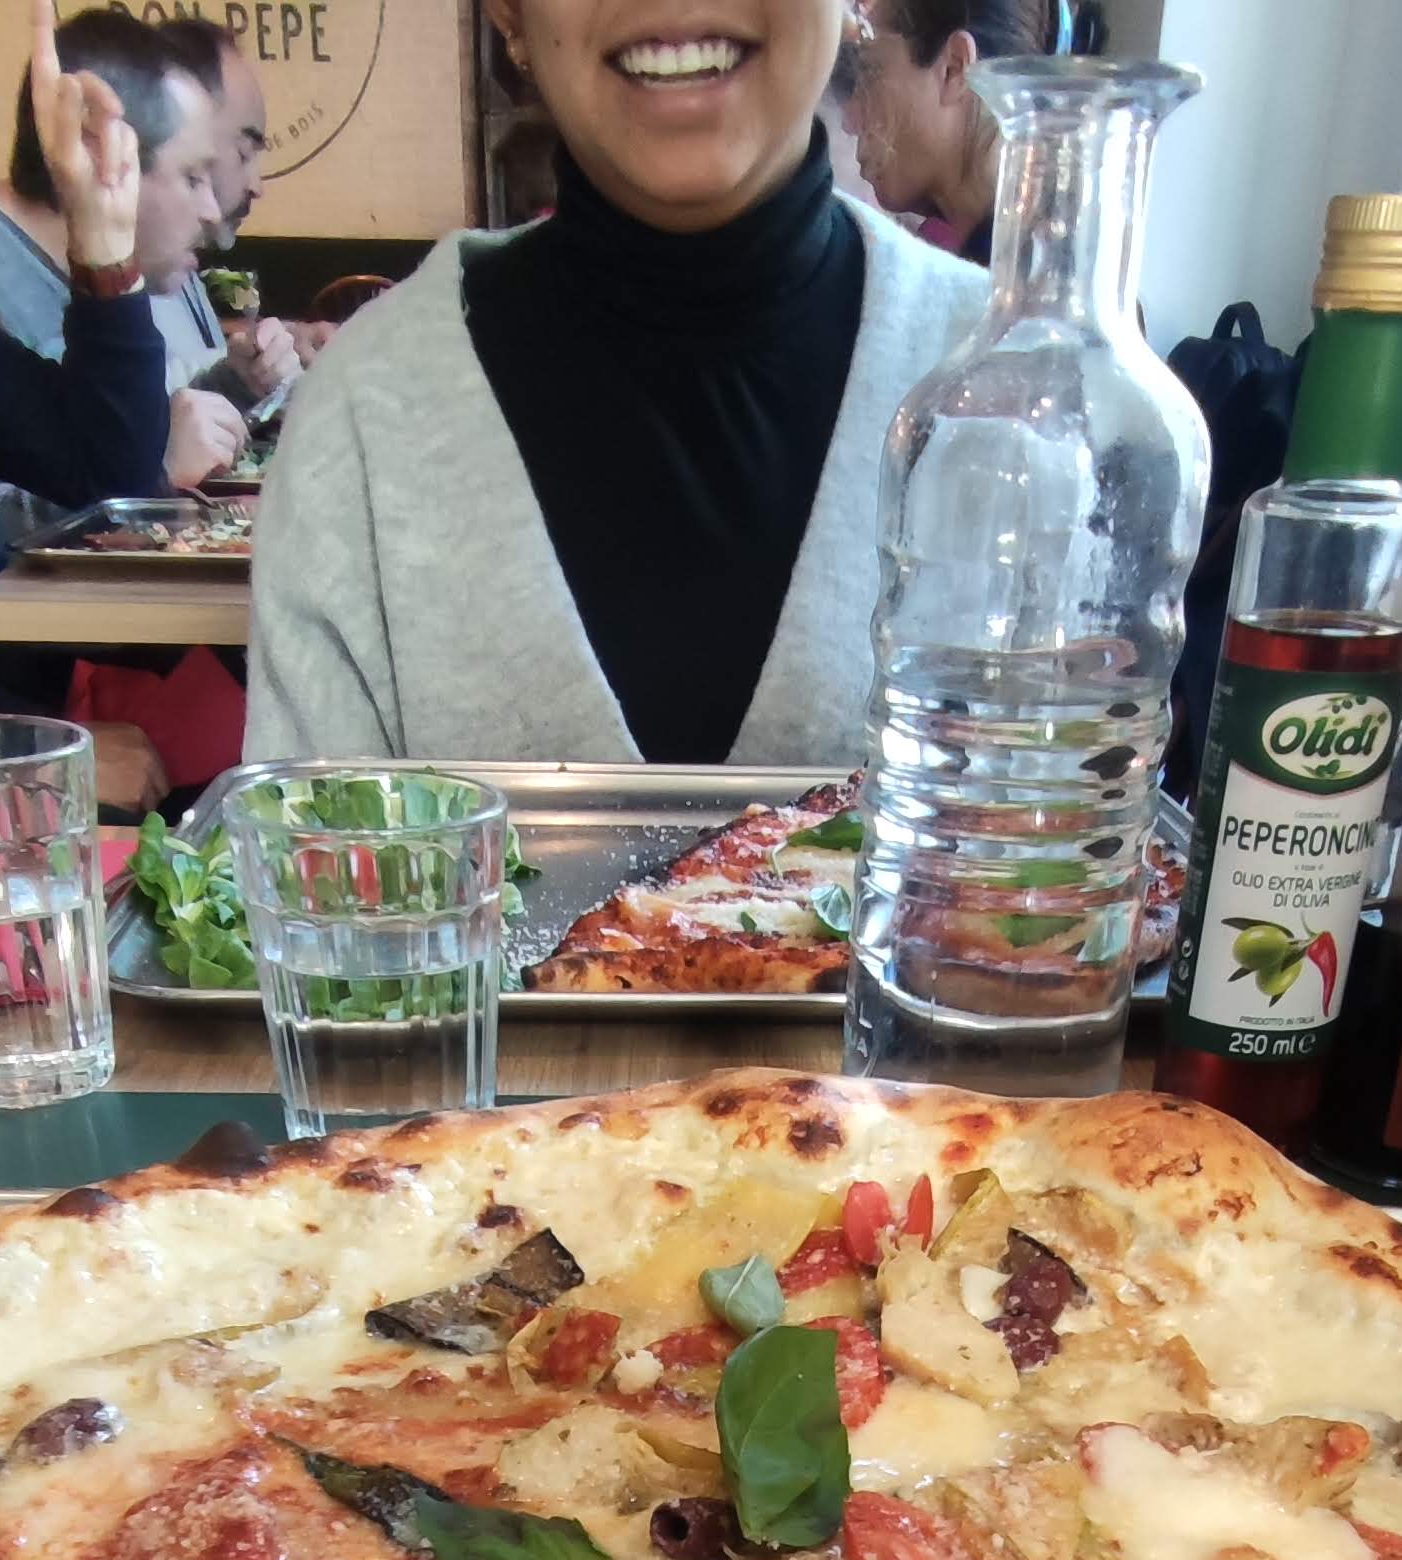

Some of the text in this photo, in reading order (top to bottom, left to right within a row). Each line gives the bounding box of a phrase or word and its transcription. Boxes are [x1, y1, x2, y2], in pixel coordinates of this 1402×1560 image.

[225, 2, 331, 62] PEPE
[286, 100, 324, 139] BOIS
[1269, 712, 1388, 757] Olidi
[1222, 815, 1382, 857] PEPERONCIN
[1232, 870, 1363, 892] OLIO EXTRA VERGINE
[1272, 893, 1330, 909] DI OLIVA
[1228, 1031, 1269, 1056] 250
[1272, 1034, 1298, 1056] ml
